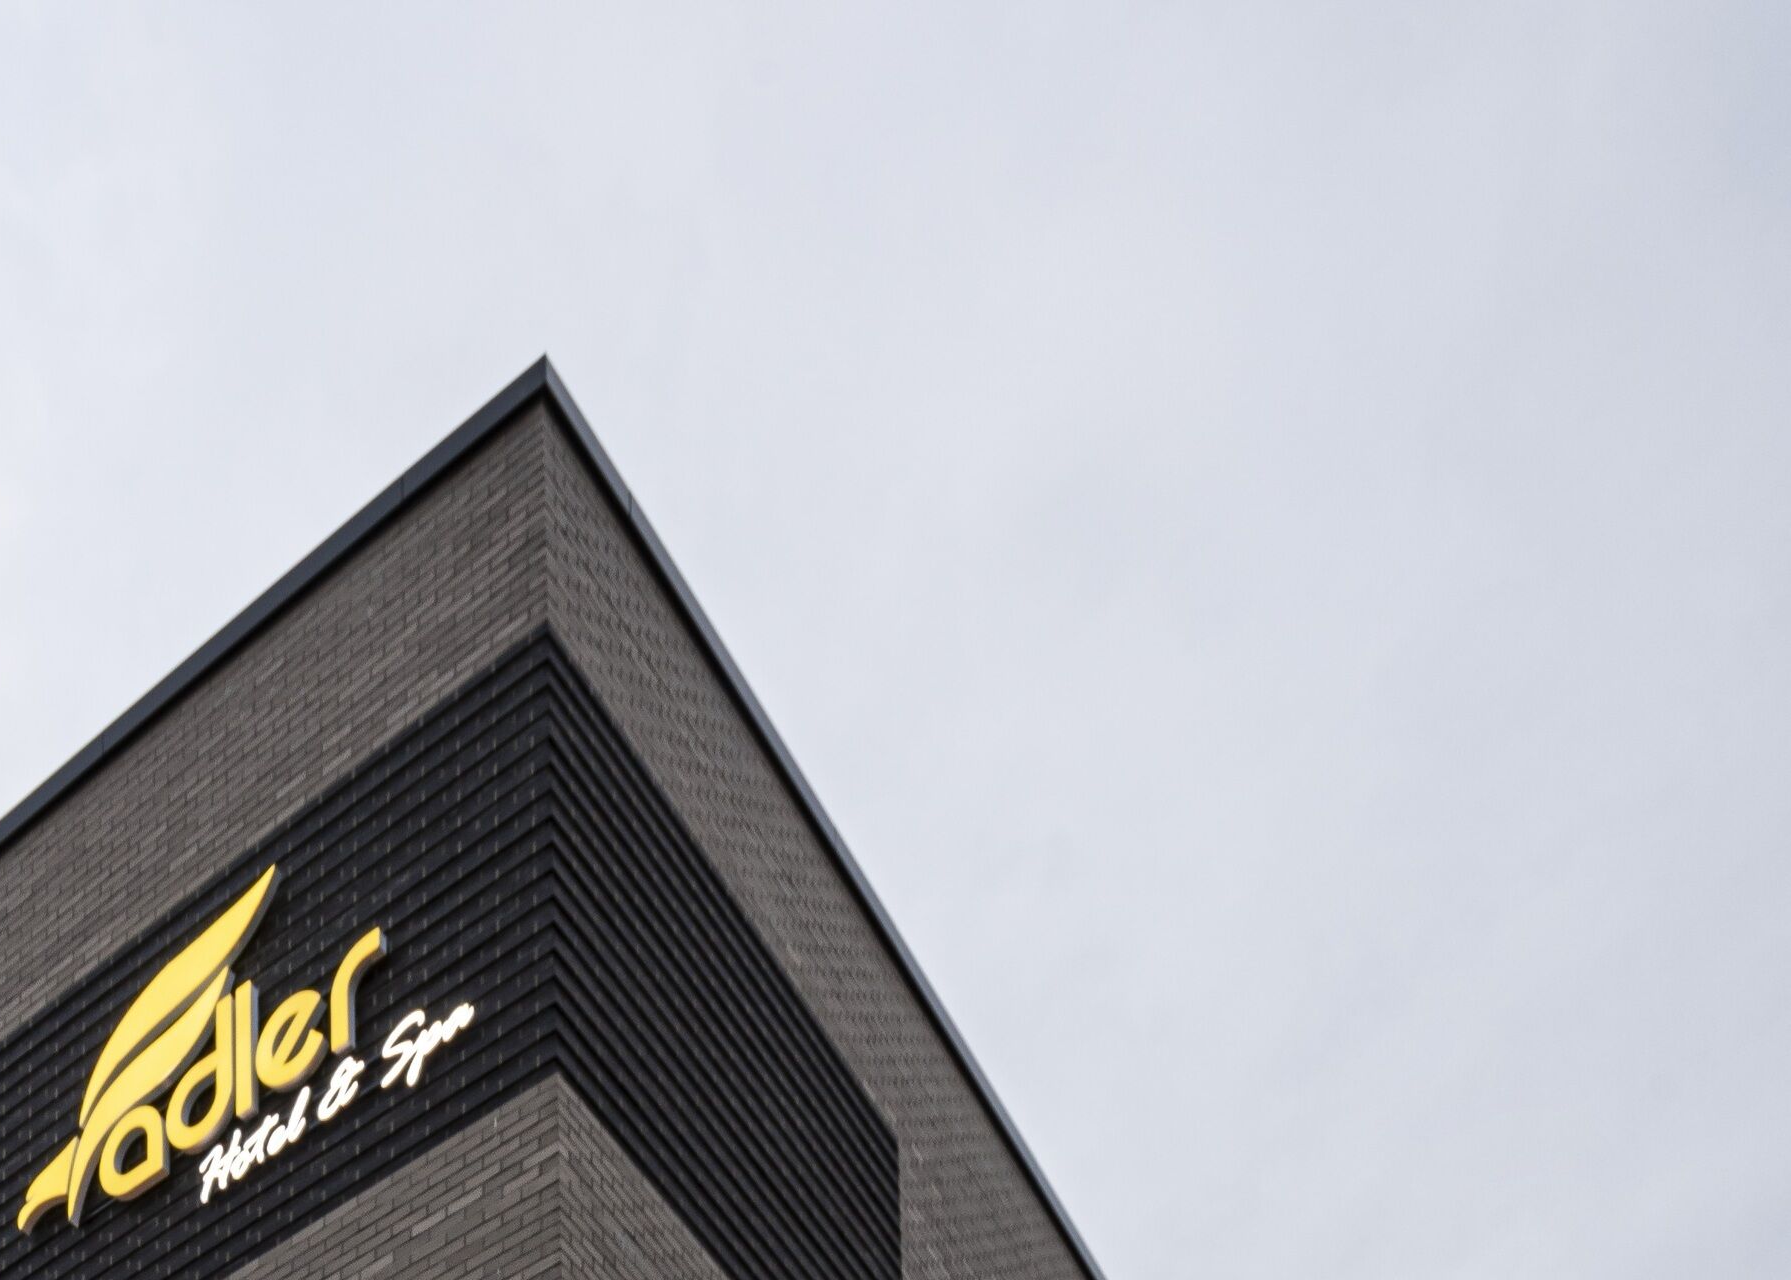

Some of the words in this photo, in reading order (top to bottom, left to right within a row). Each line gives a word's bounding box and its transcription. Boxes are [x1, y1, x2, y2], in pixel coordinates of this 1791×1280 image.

[99, 926, 387, 1200] adler
[199, 1086, 310, 1204] Hotel
[317, 1056, 365, 1121] &
[380, 1002, 474, 1088] Spa
